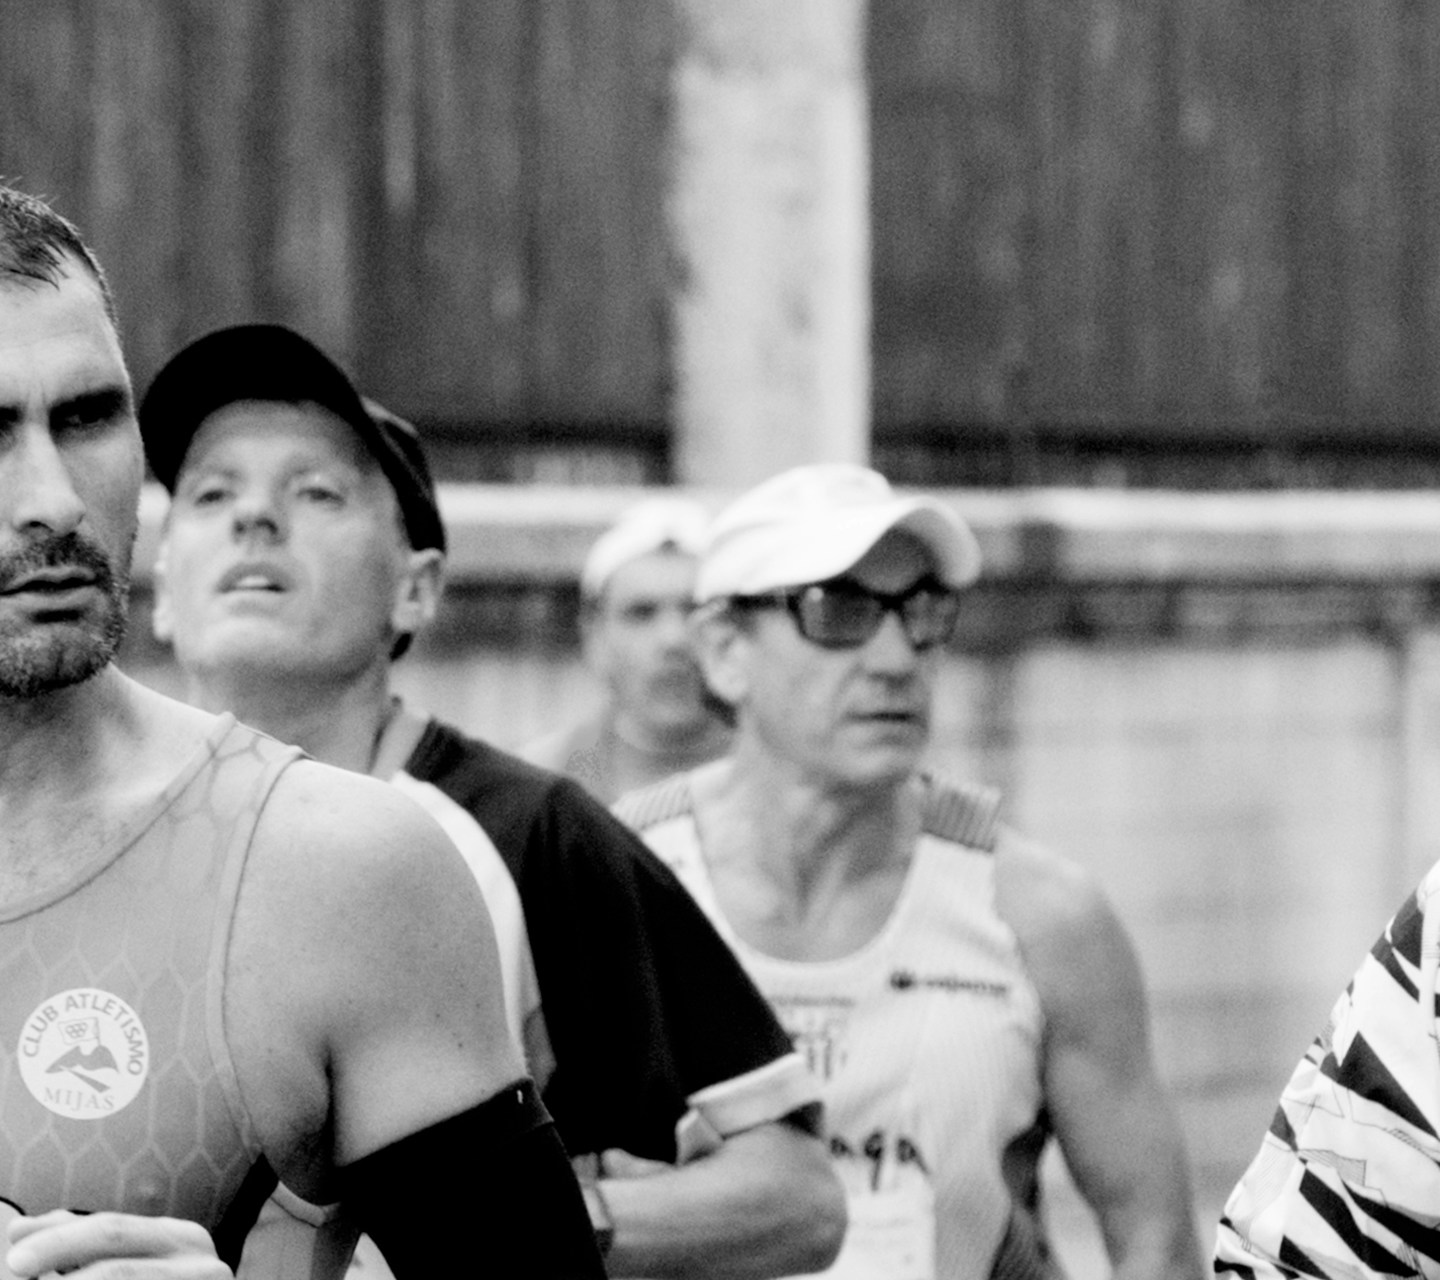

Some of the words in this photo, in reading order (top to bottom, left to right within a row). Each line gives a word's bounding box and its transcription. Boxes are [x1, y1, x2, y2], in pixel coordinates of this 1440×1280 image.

[23, 1005, 59, 1058] CLUB
[65, 993, 145, 1076] ATLETISMO
[43, 1086, 115, 1111] MIJAS
